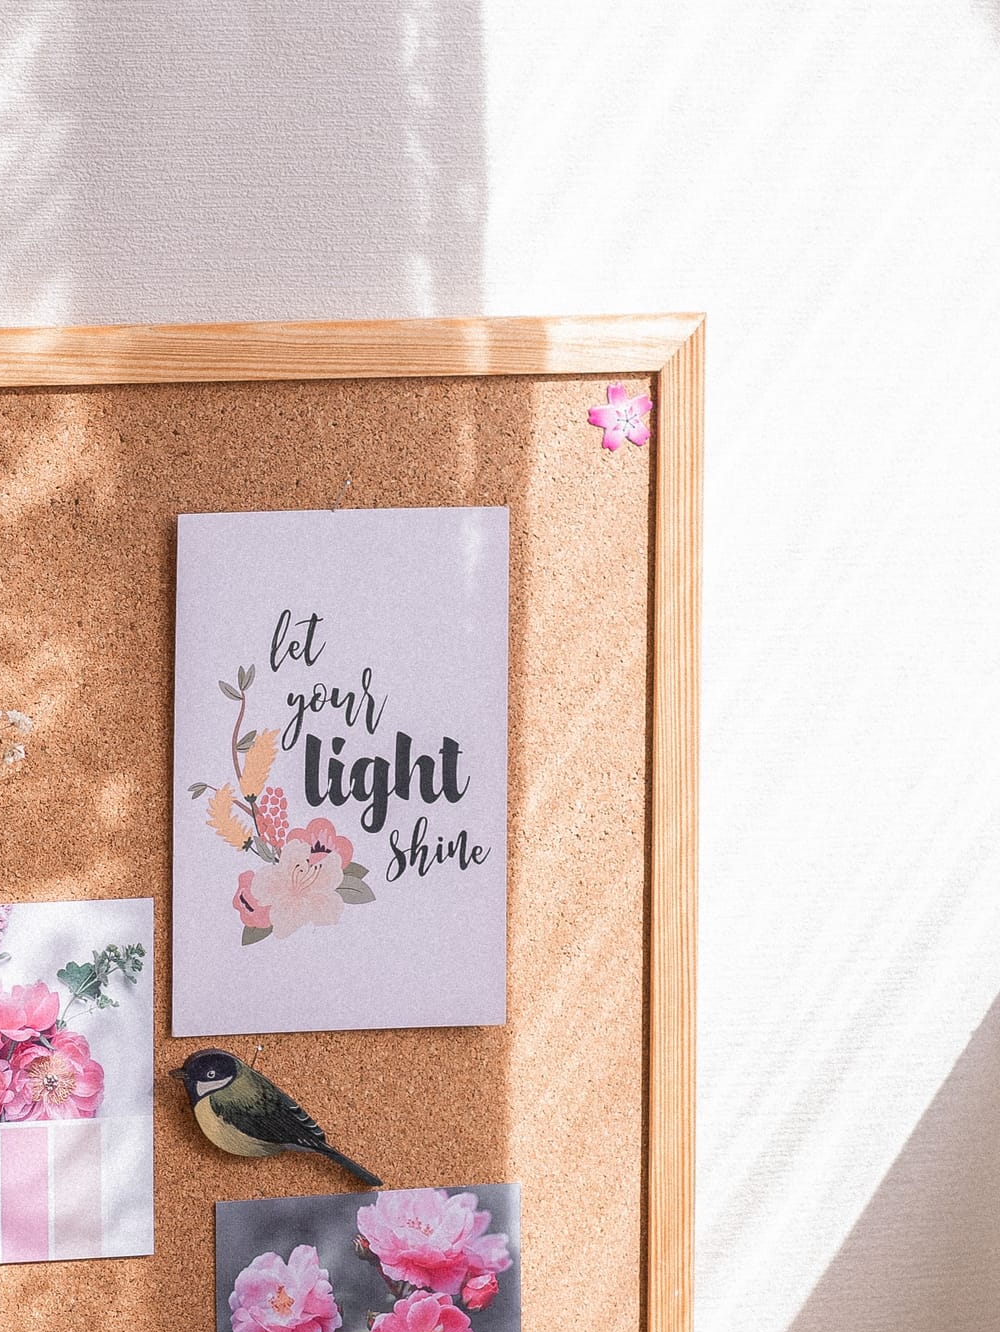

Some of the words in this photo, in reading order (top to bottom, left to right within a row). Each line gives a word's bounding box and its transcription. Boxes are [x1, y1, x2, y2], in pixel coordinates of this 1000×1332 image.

[270, 609, 326, 672] let
[281, 668, 388, 750] your
[304, 731, 470, 833] light
[386, 816, 491, 882] shine
